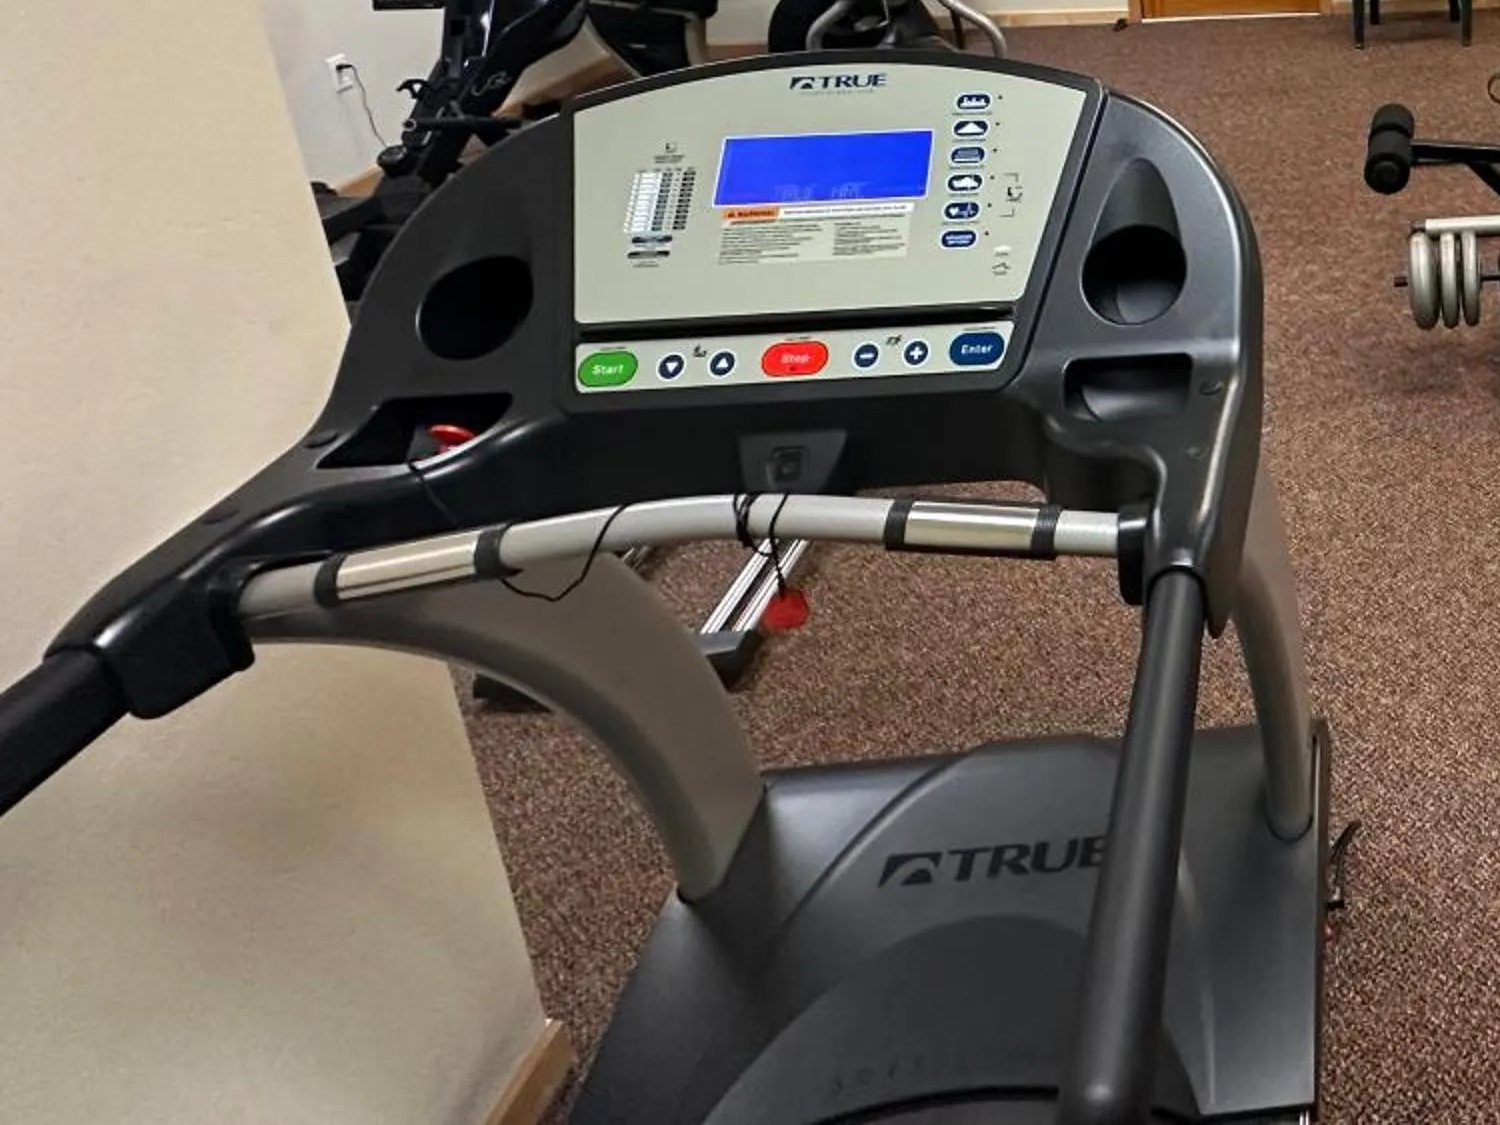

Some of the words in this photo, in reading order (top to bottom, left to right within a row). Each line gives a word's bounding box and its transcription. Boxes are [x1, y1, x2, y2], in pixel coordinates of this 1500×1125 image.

[818, 72, 887, 89] TRUE
[961, 343, 993, 355] Enter
[591, 363, 625, 376] Start
[947, 834, 1107, 882] TRUE
